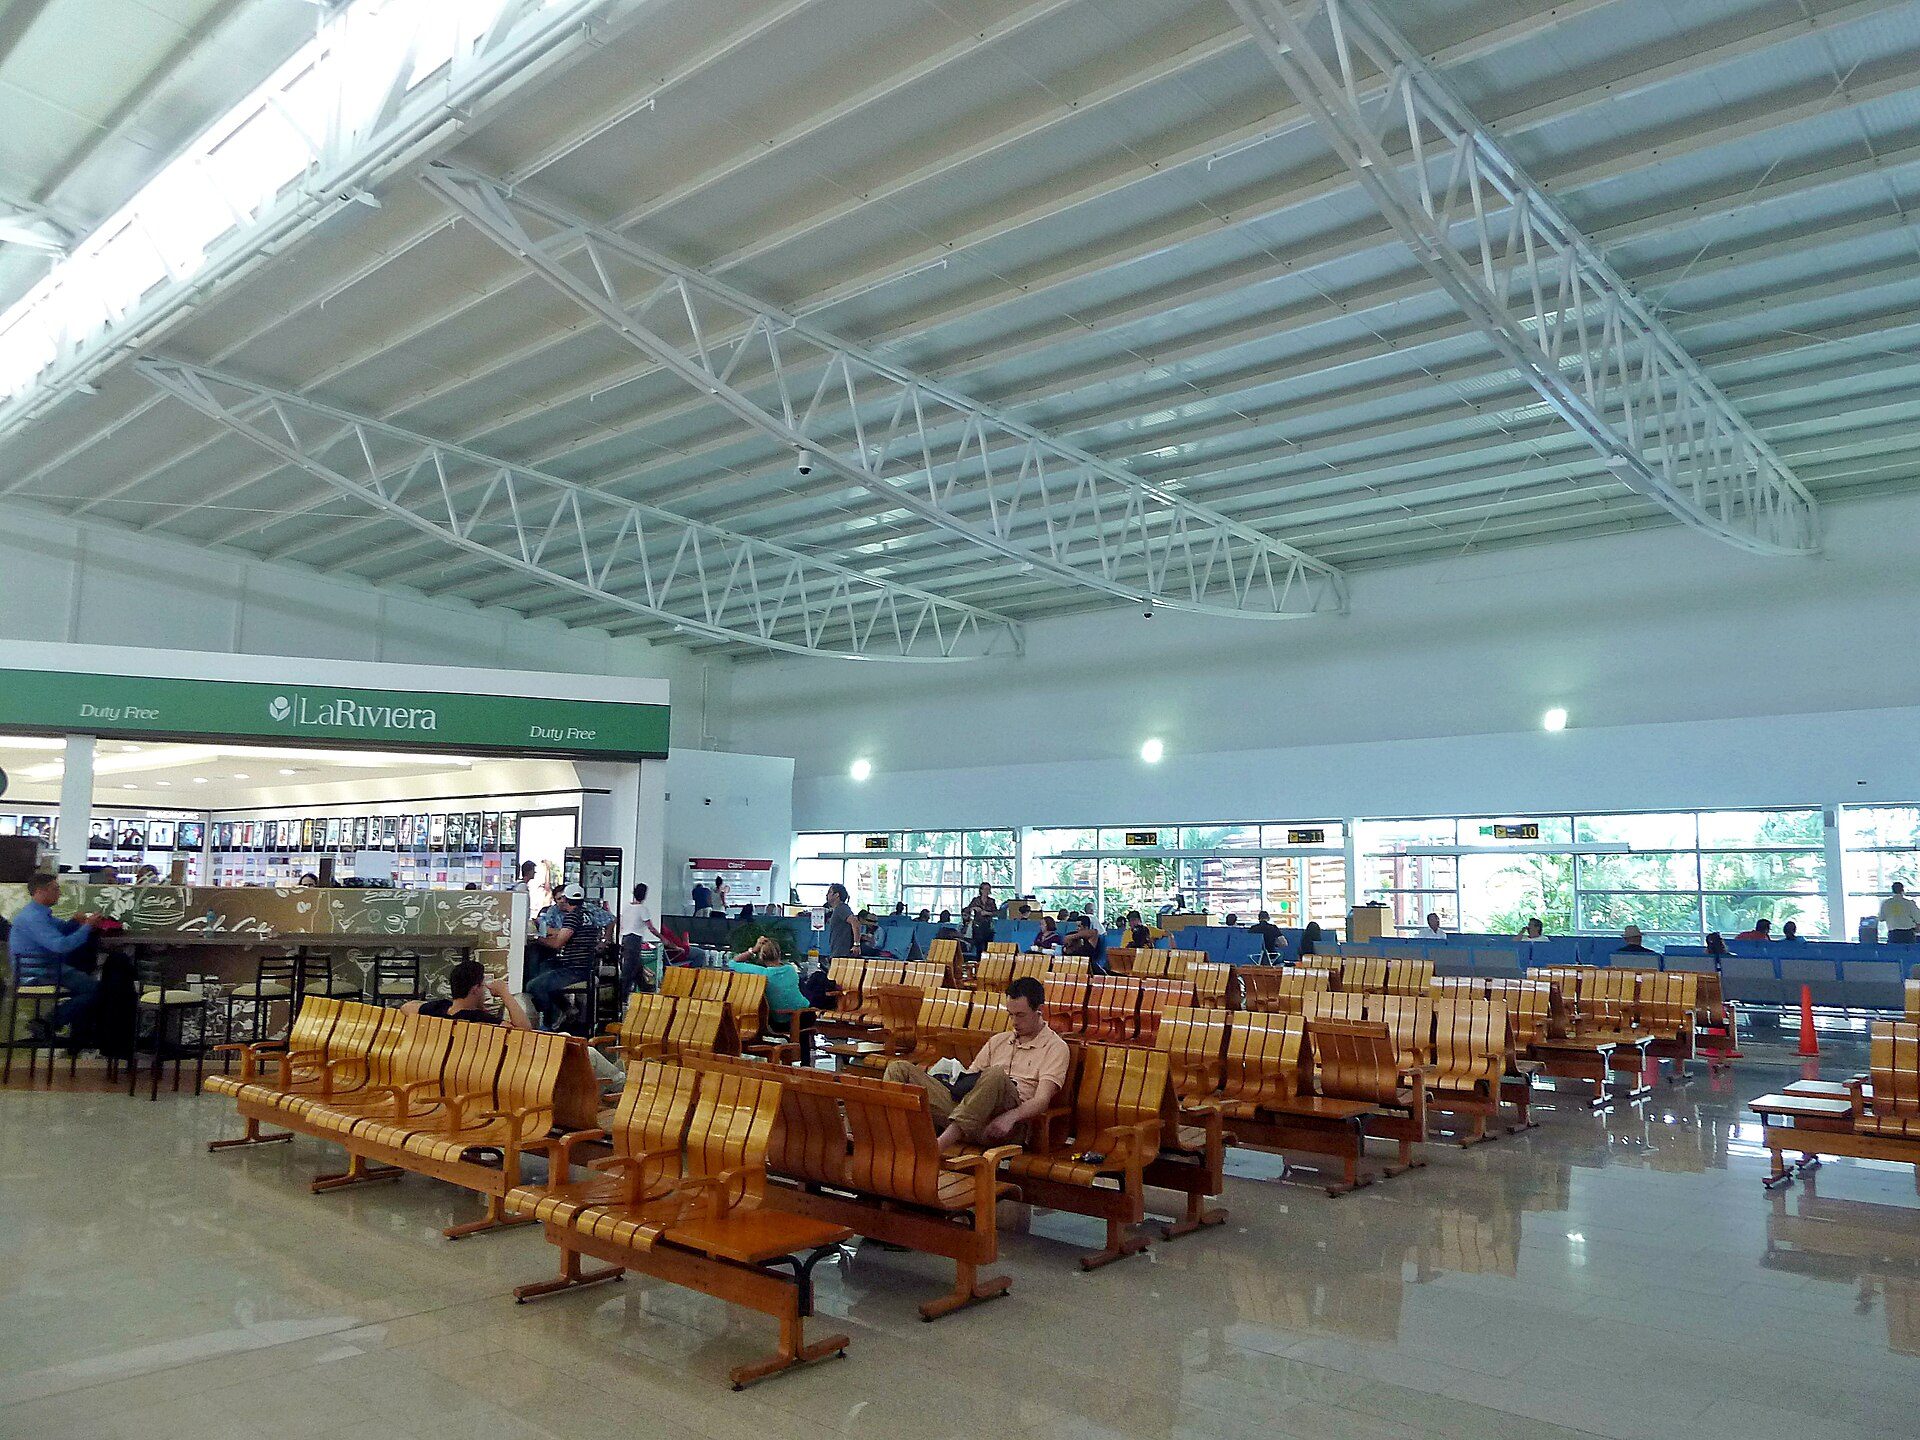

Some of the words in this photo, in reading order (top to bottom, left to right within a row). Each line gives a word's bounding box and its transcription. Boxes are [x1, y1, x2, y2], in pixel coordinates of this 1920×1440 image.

[80, 703, 120, 721] Duty
[124, 706, 160, 720] Free
[299, 697, 437, 730] LaRiviera
[529, 725, 564, 741] Duty
[566, 727, 597, 740] Free
[1145, 834, 1156, 844] 12
[1521, 826, 1537, 838] 10
